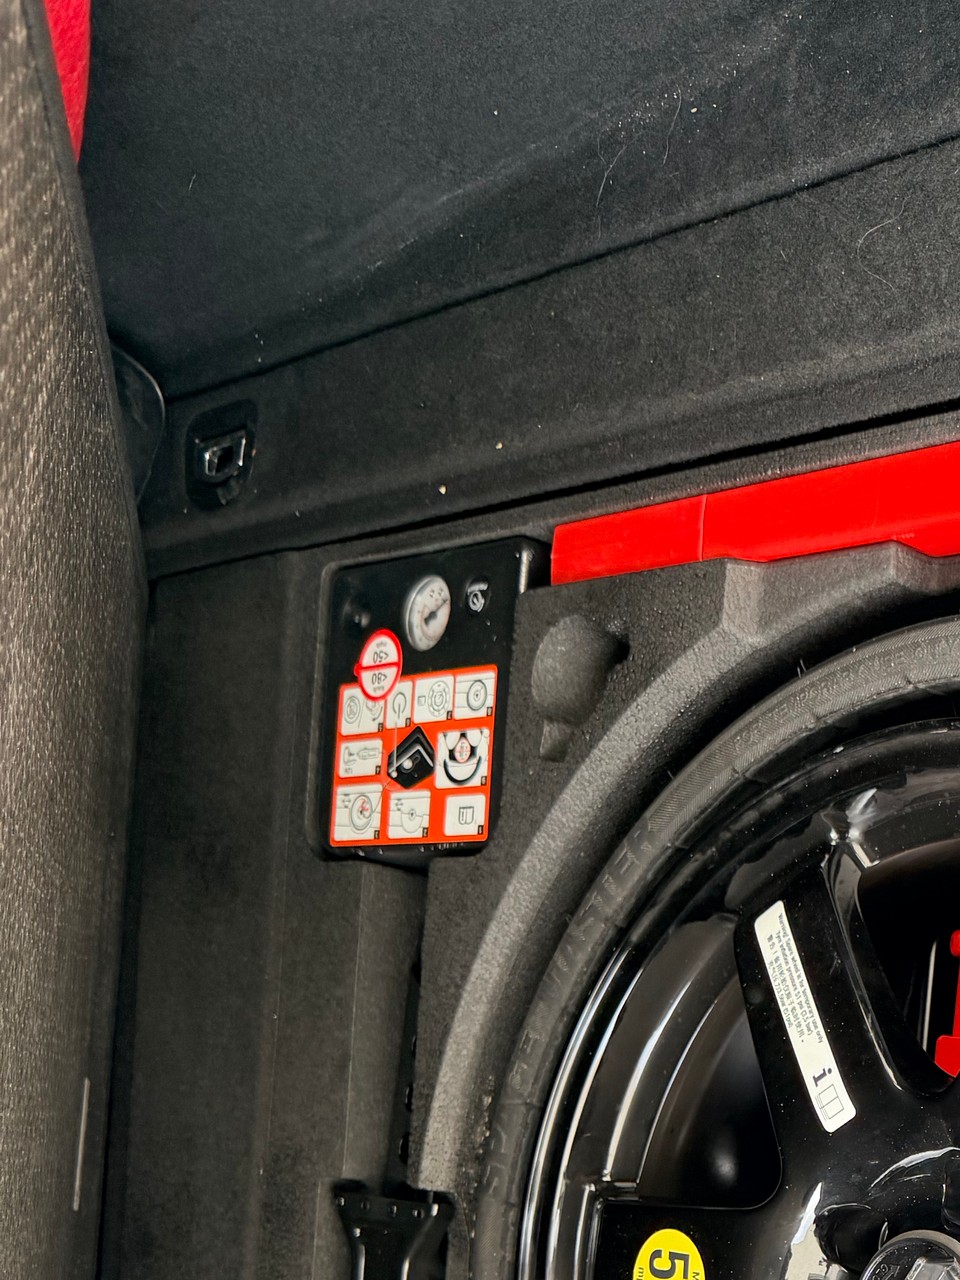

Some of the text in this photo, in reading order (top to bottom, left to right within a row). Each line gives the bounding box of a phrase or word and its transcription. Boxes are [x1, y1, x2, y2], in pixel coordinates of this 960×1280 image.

[786, 966, 798, 992] pressure
[791, 955, 800, 974] wheel
[801, 988, 814, 1019] temporary
[811, 1018, 819, 1031] use
[815, 1030, 824, 1044] only
